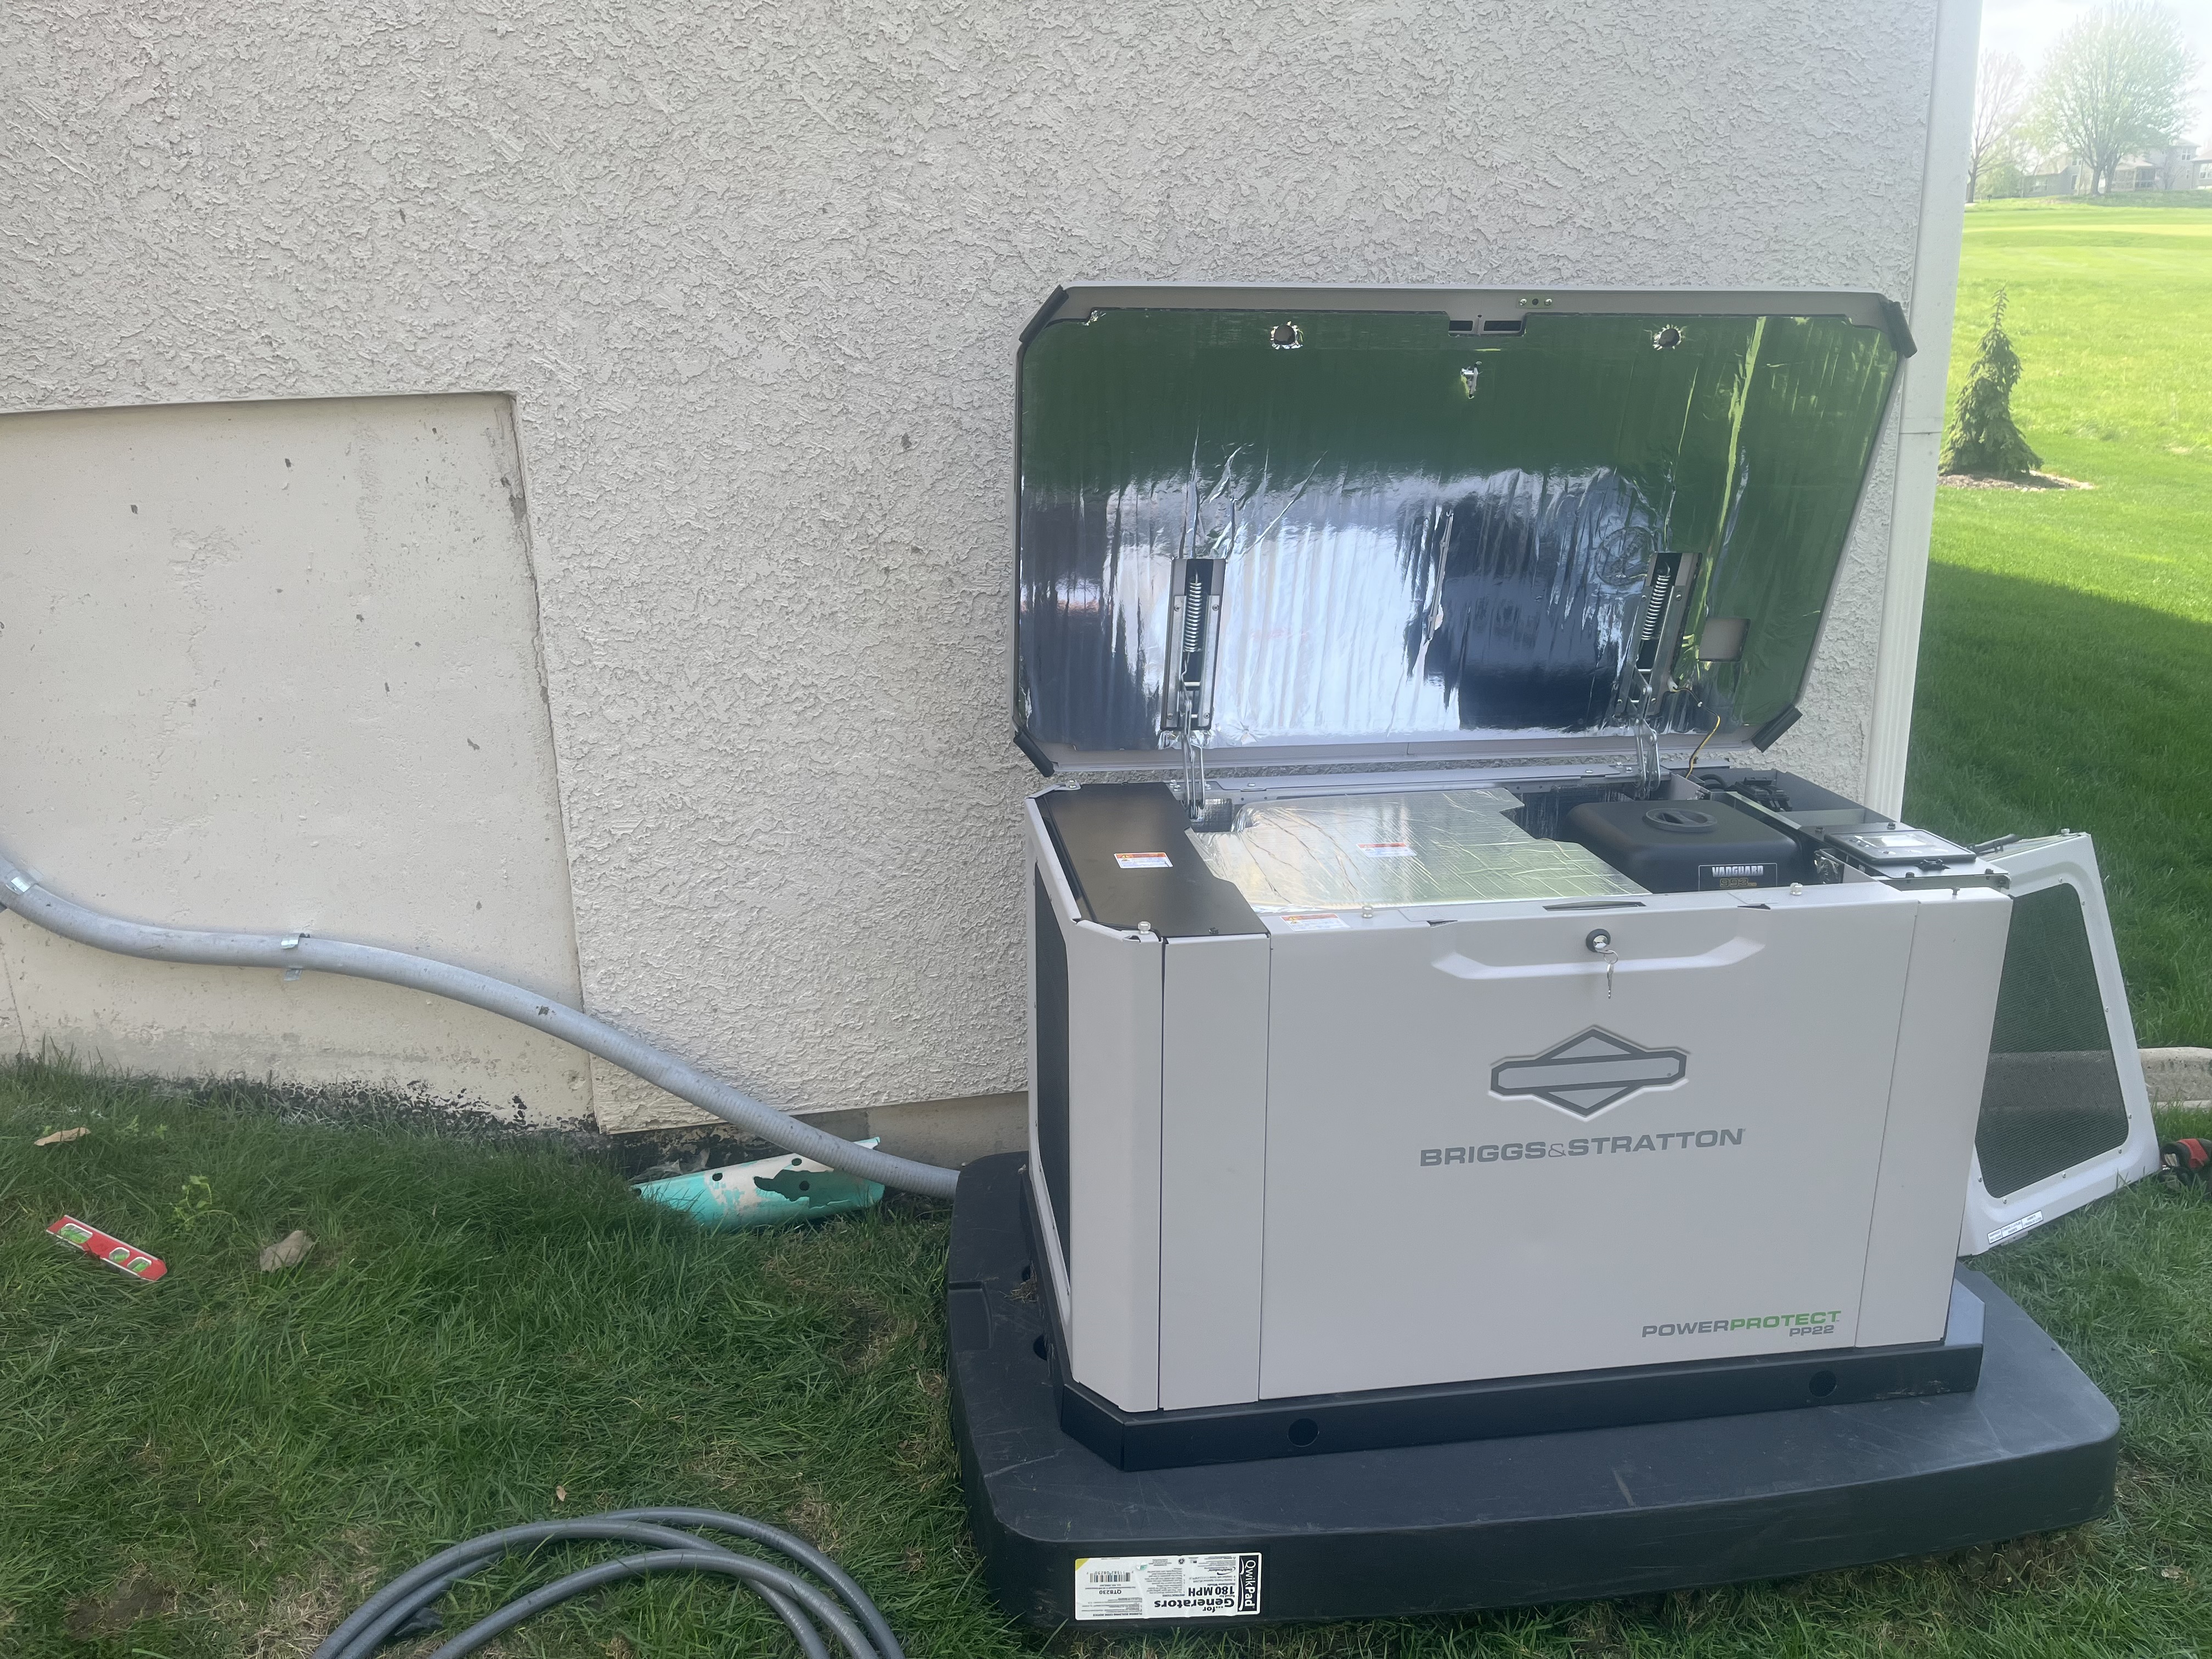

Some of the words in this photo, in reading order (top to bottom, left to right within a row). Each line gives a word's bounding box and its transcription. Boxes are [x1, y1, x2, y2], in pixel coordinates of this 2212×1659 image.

[1712, 865, 1764, 877] VANGUARD
[1789, 1325, 1835, 1337] PP22
[1245, 1560, 1256, 1607] QwikPad
[1188, 1587, 1213, 1596] MPH
[1215, 1586, 1234, 1595] 180
[1154, 1598, 1235, 1610] Generators
